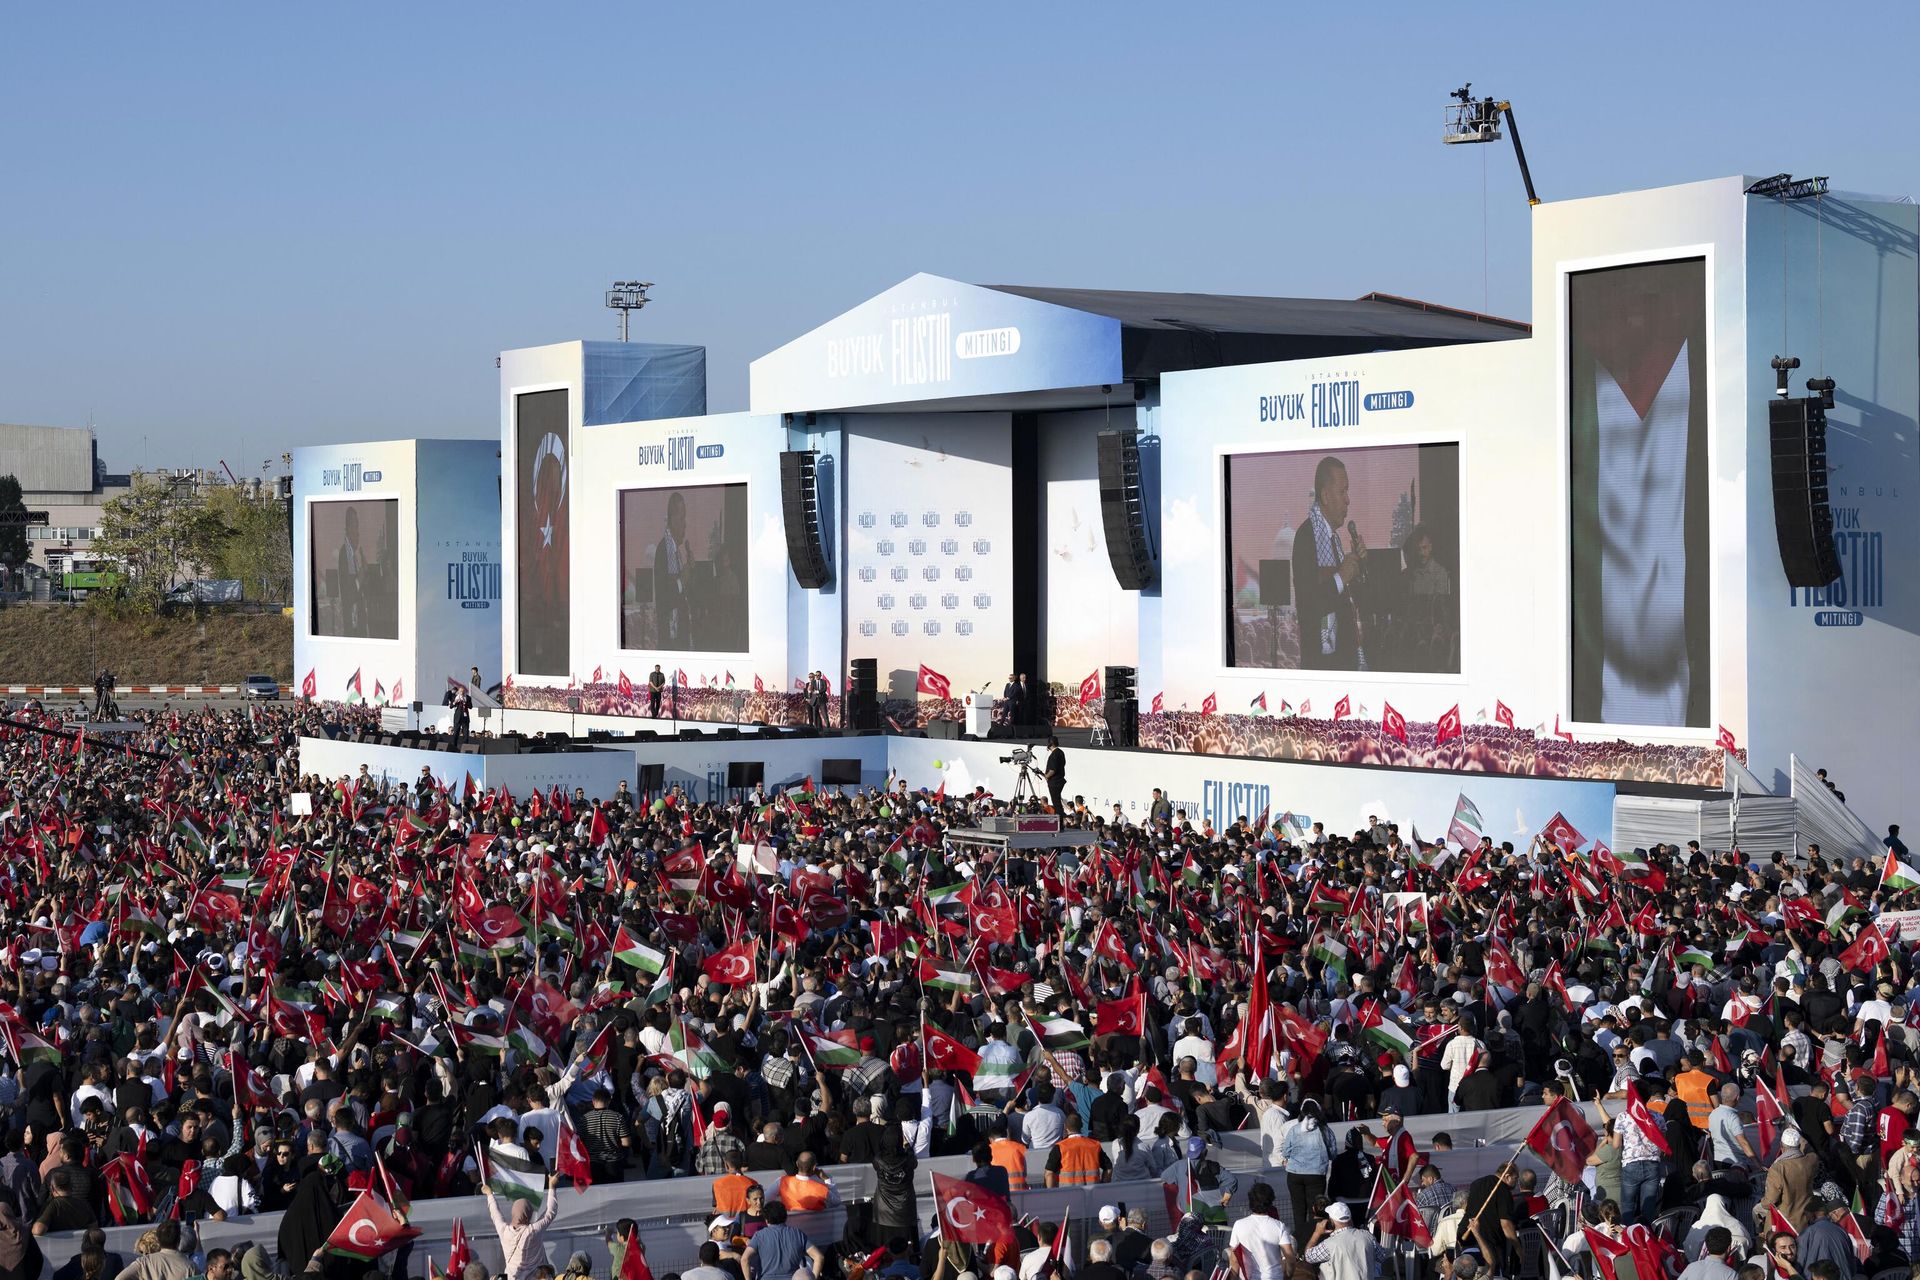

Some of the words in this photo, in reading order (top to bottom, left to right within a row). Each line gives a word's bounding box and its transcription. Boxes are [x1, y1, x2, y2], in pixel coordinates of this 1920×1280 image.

[1260, 393, 1305, 422] BÜYÜK
[639, 445, 665, 466] BÜYÜK
[462, 552, 488, 562] BÜYÜK
